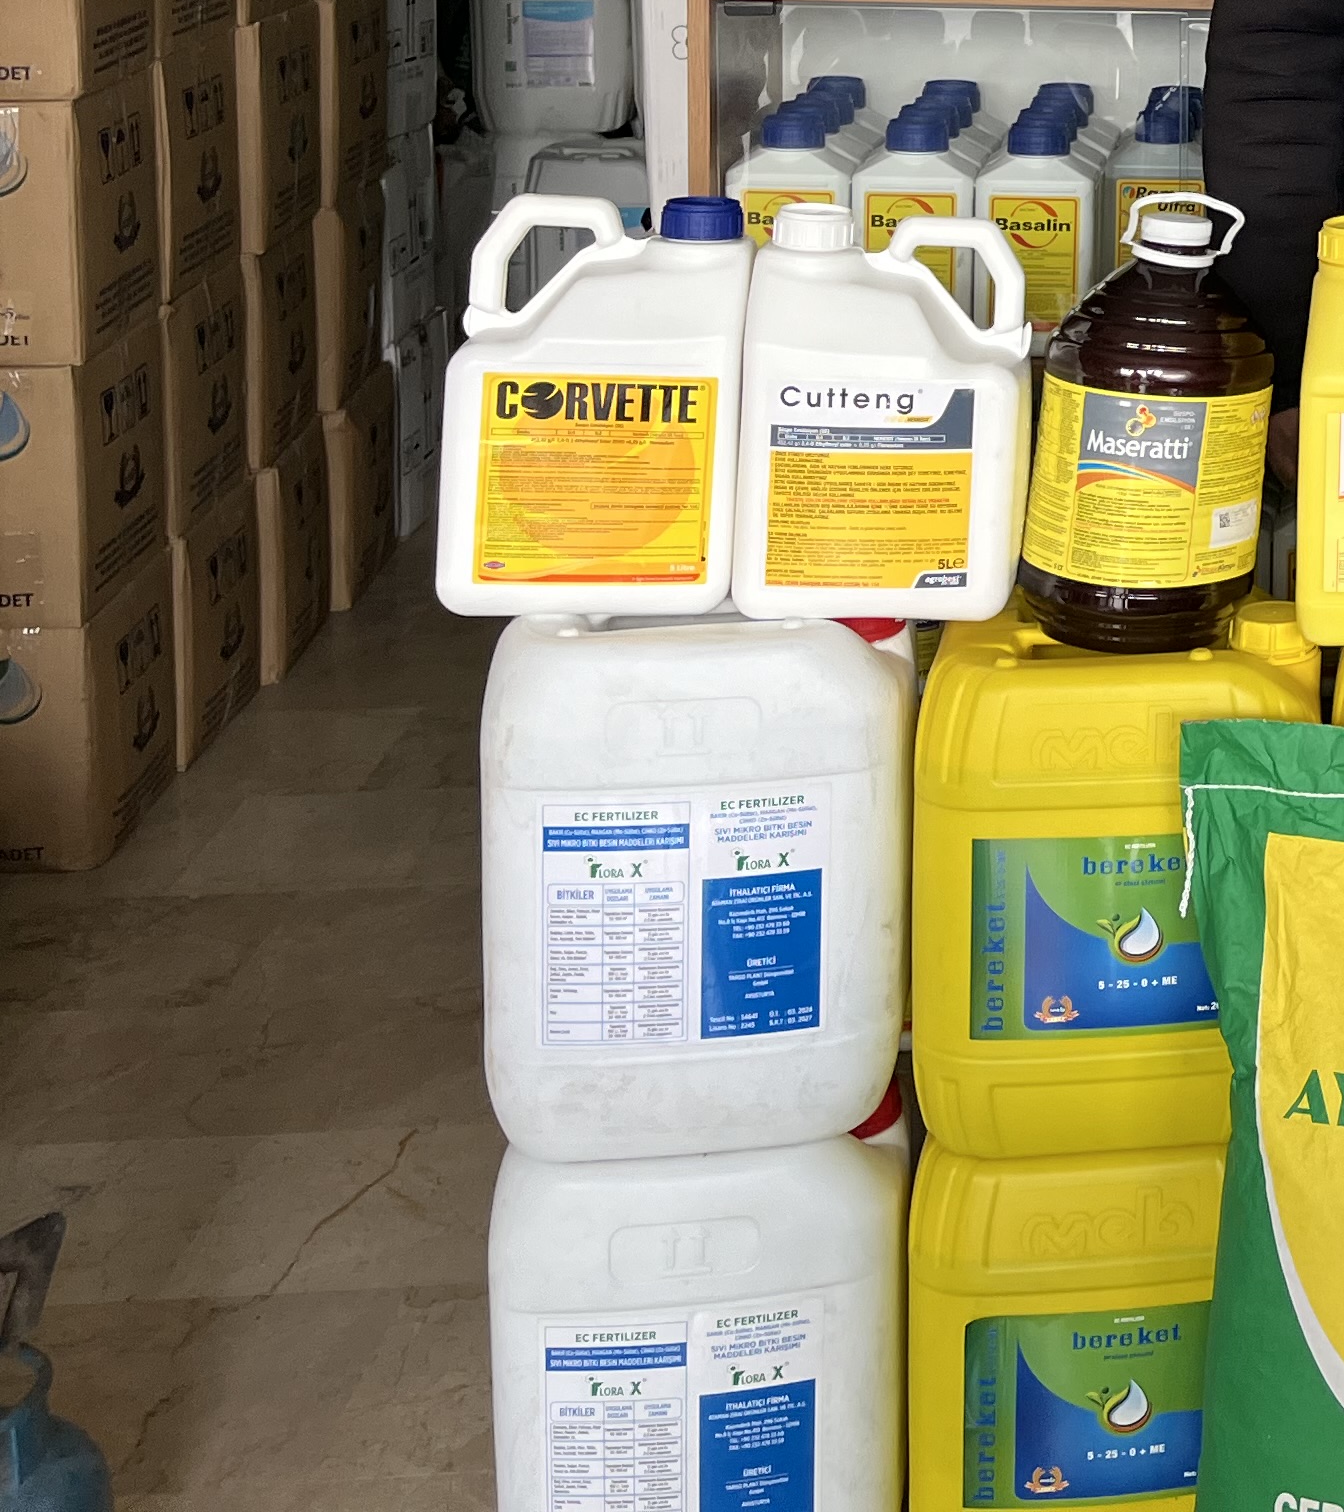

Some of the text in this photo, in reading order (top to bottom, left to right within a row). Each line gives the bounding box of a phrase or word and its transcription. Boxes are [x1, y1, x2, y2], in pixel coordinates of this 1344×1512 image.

[996, 216, 1071, 232] Basalin
[496, 381, 698, 423] CORVETTE
[781, 386, 914, 415] Cutteng
[1087, 429, 1189, 460] Maseratti
[574, 811, 658, 822] EC FERTILIZER
[575, 1331, 657, 1343] EC FERTILIZER
[1072, 1323, 1182, 1351] bereket
